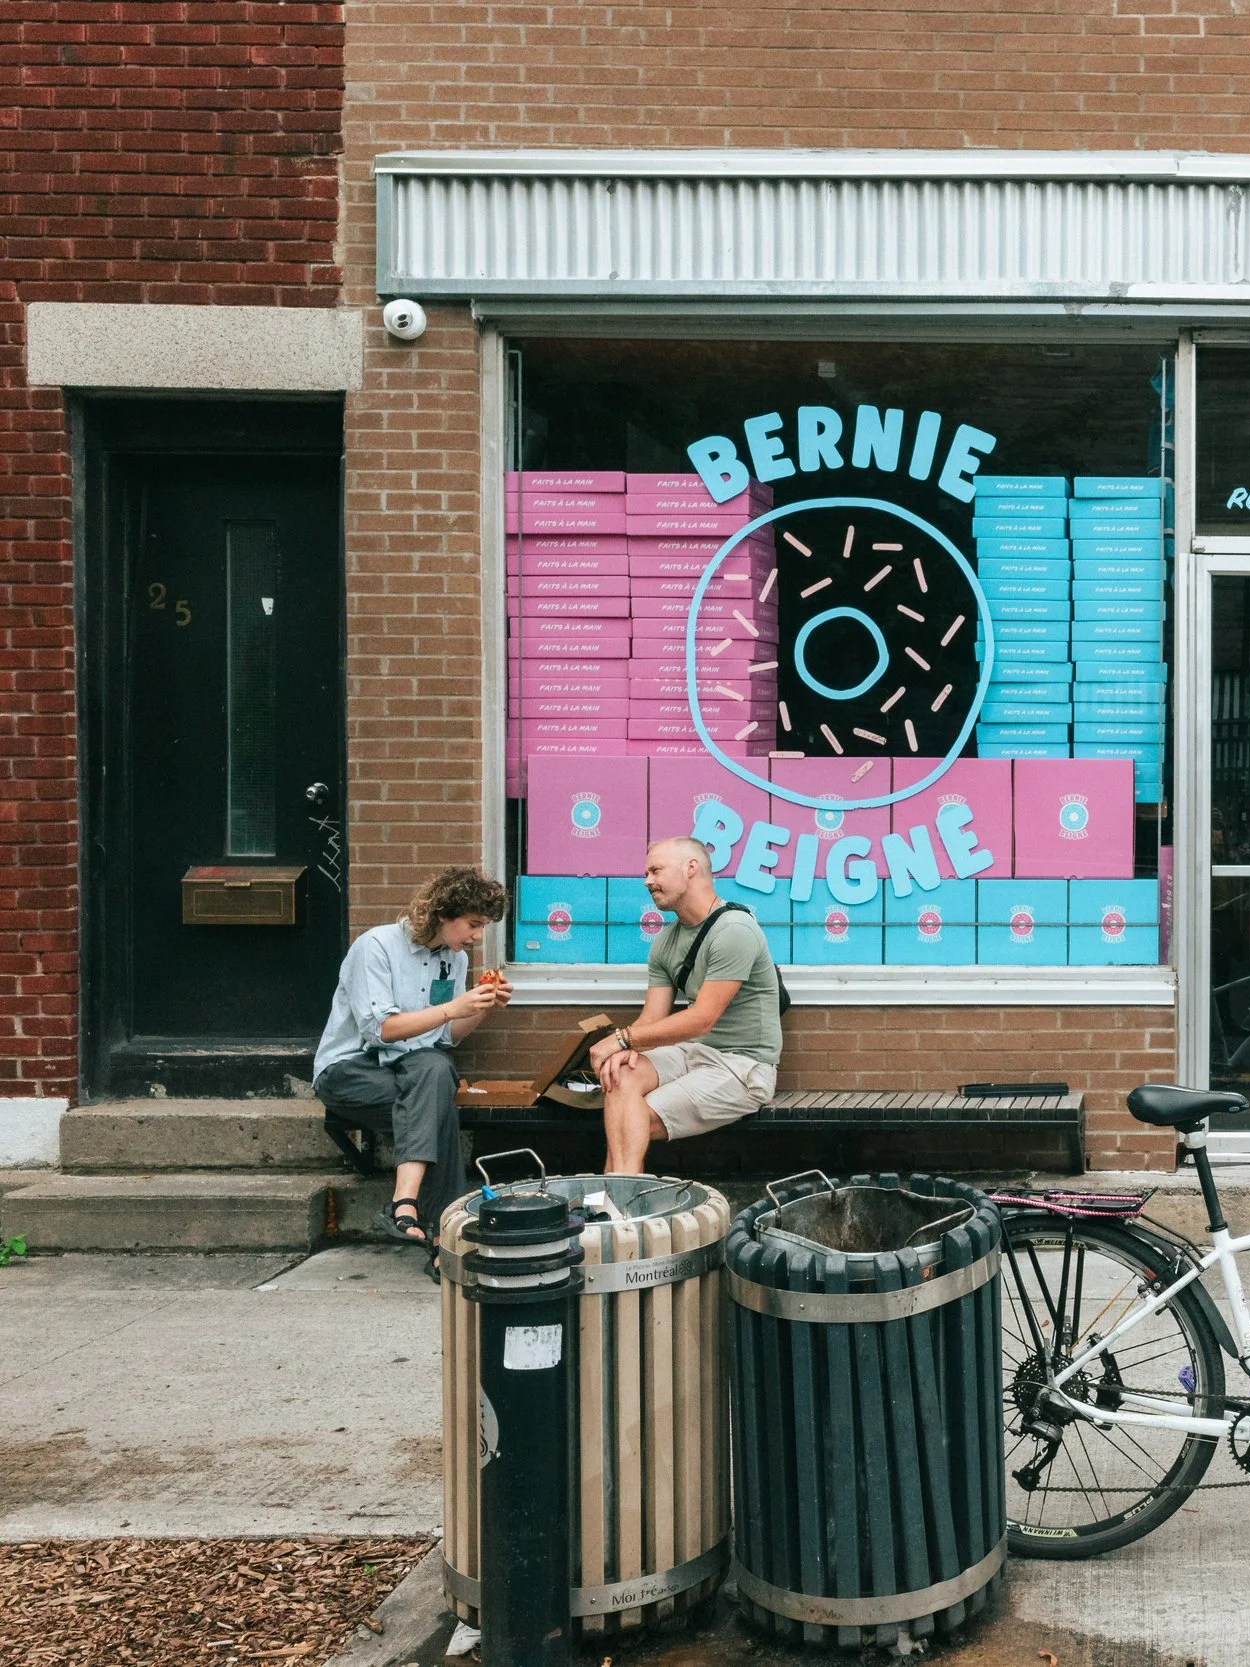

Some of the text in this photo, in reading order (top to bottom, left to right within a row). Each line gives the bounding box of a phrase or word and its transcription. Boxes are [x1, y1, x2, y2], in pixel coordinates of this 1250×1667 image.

[687, 404, 997, 503] BERNIE
[690, 799, 995, 905] BEIGNE
[626, 1264, 678, 1284] Montréal
[1124, 1496, 1154, 1520] PLUS
[1022, 1526, 1063, 1536] WEINMANN
